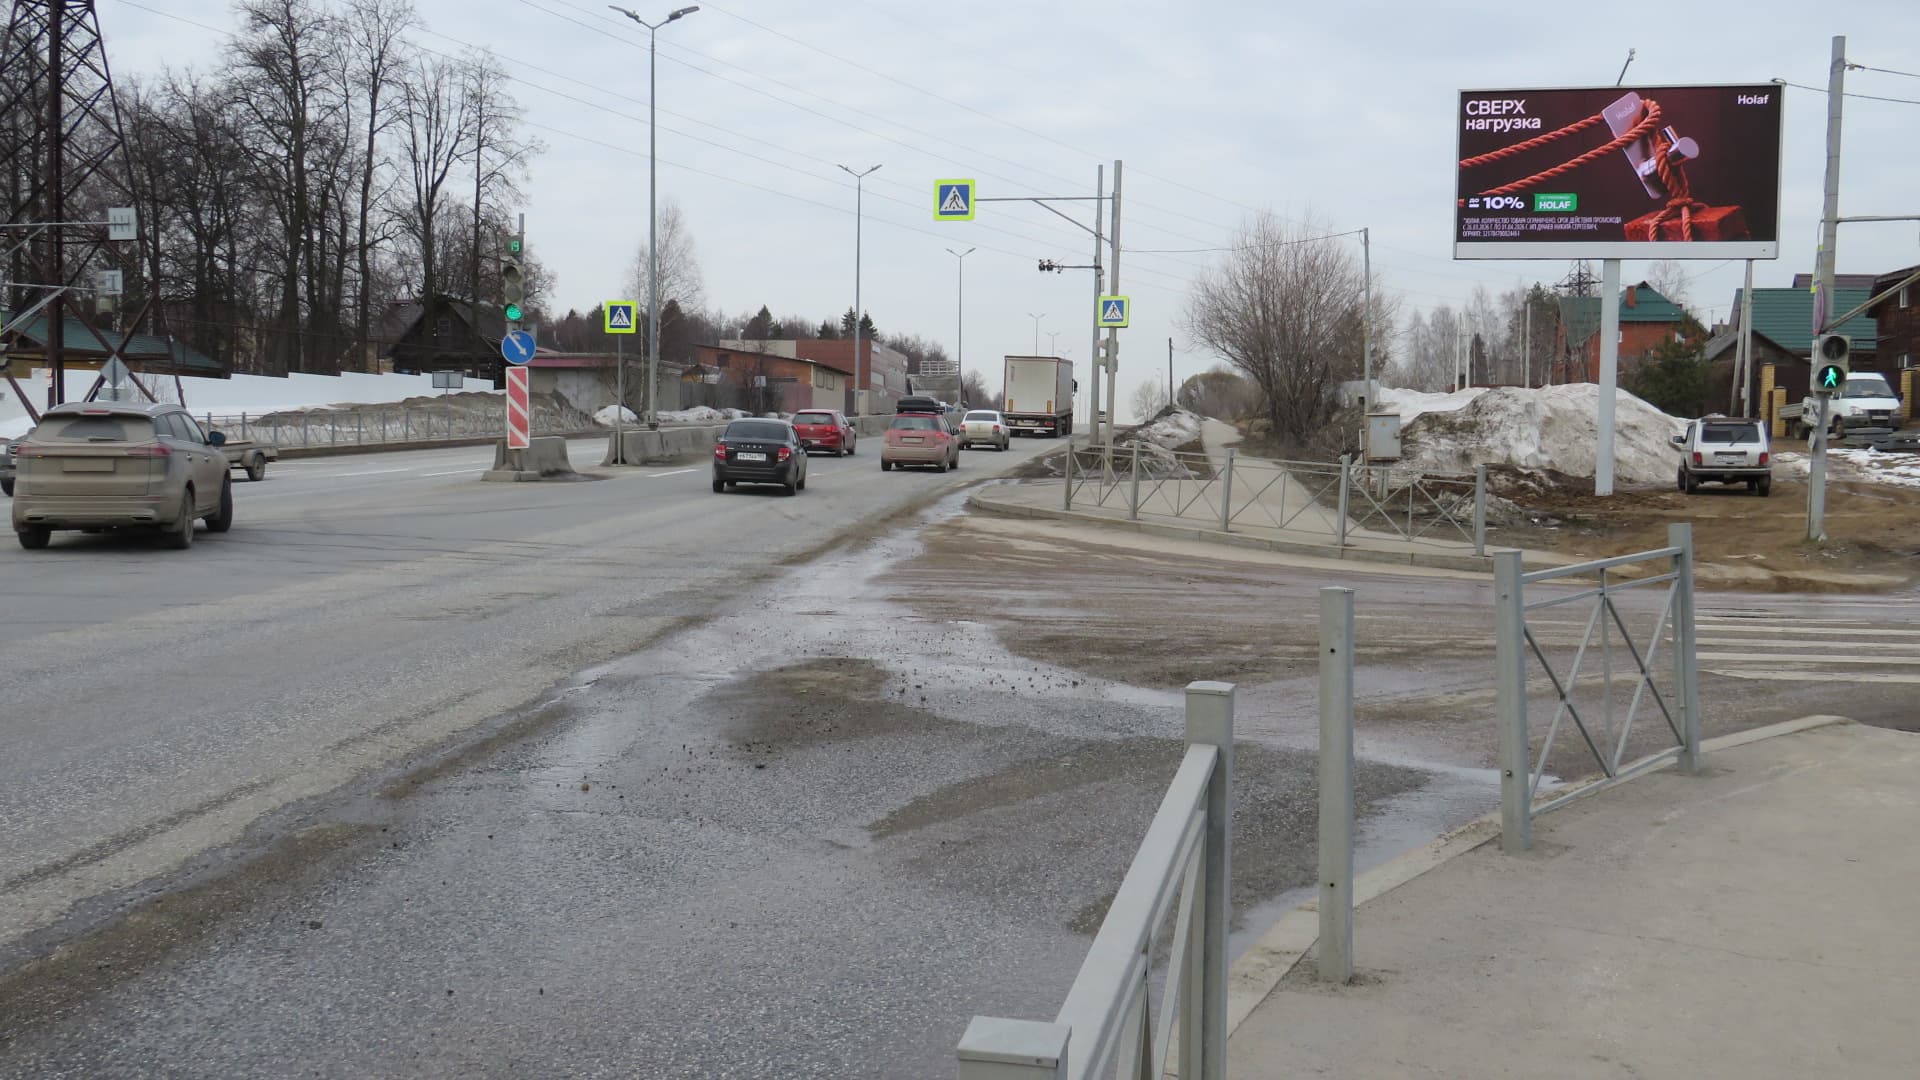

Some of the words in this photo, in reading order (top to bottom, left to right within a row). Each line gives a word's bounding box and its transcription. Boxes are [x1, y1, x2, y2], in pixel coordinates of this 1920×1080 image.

[1737, 94, 1769, 105] Holaf
[1465, 99, 1526, 116] СВЕРХ
[1465, 117, 1542, 133] нагрузка
[1539, 201, 1571, 209] HOLAF
